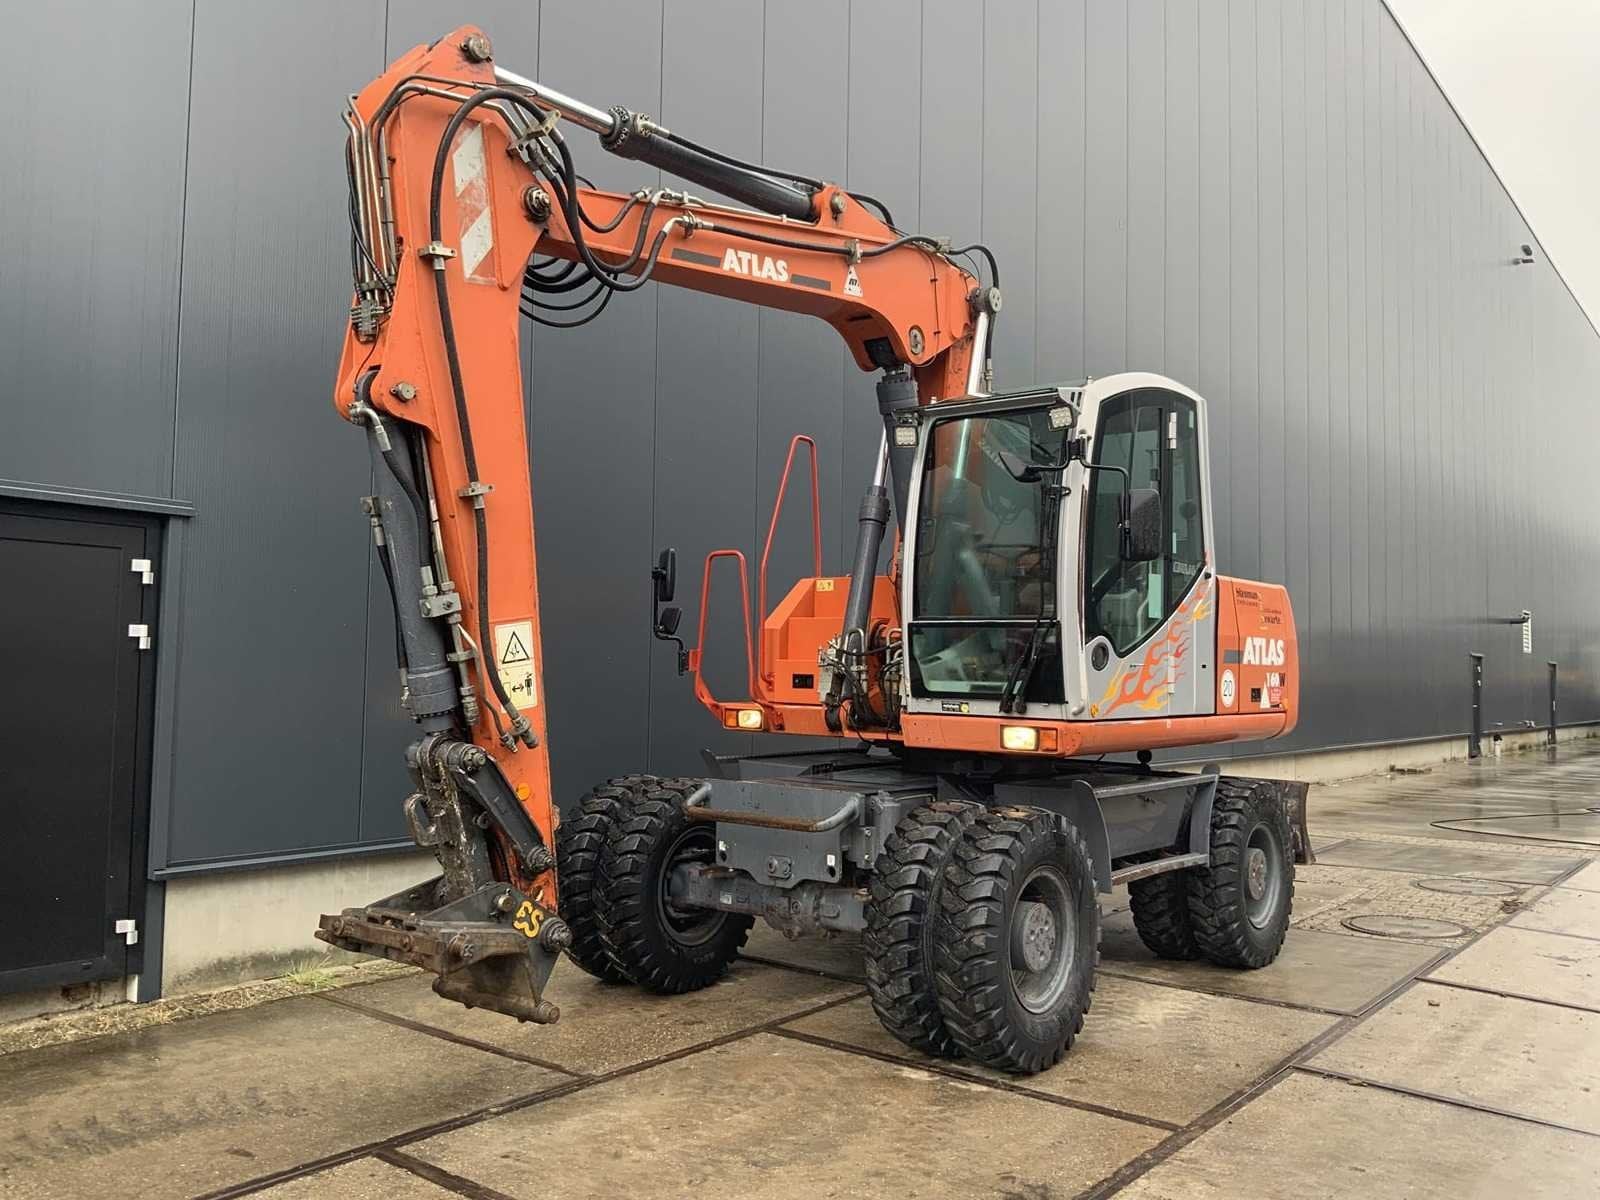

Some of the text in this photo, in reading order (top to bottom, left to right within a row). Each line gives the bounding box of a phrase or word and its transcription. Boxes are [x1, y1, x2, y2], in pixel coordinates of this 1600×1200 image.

[722, 247, 790, 283] ATLAS
[1242, 636, 1285, 666] ATLAS
[1223, 679, 1233, 697] 20
